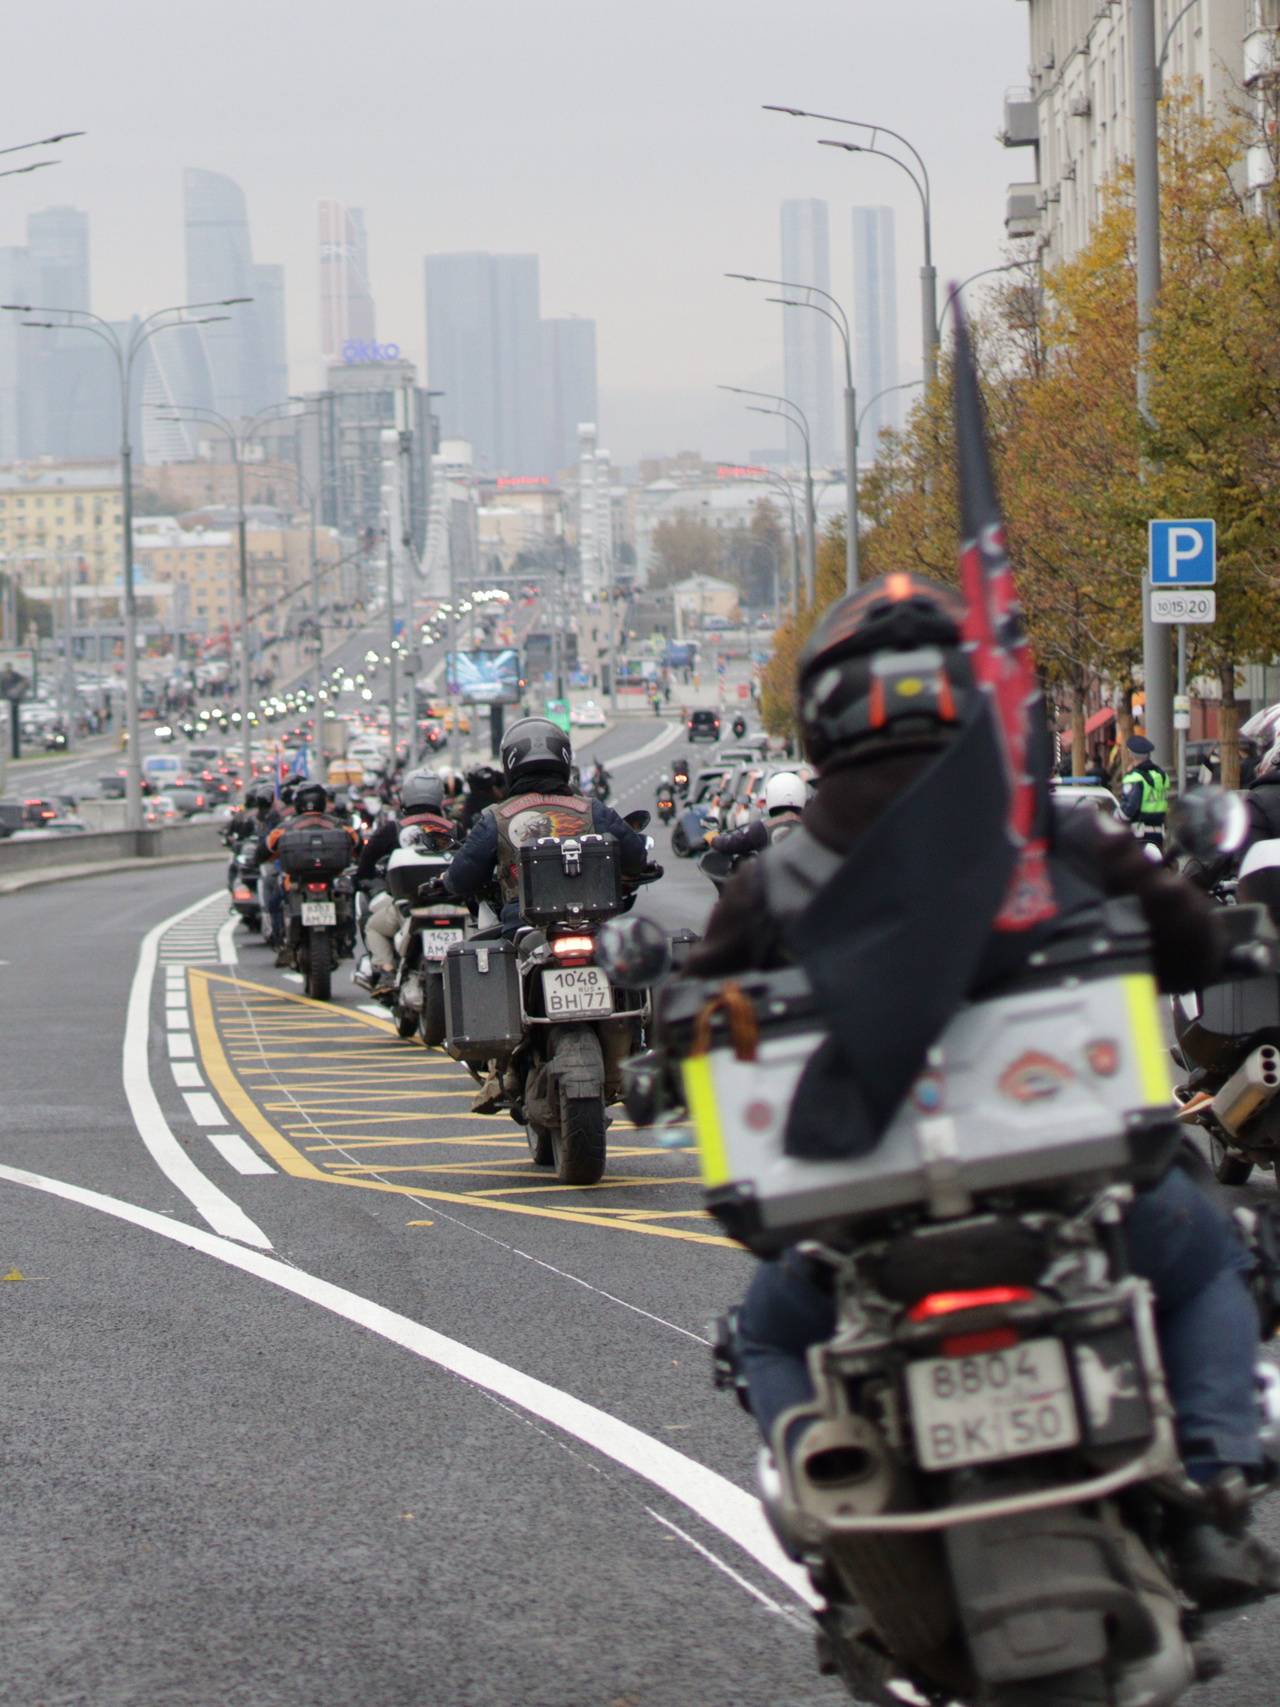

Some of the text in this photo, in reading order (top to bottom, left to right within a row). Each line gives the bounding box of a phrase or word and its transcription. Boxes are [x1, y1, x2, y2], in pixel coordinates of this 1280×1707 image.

[1167, 527, 1204, 578] P
[1158, 600, 1207, 613] 10 15 20
[429, 931, 458, 942] 1423
[554, 970, 599, 989] 1048
[583, 992, 606, 1008] 77
[931, 1348, 1040, 1400] 8804
[1010, 1404, 1062, 1445] 50
